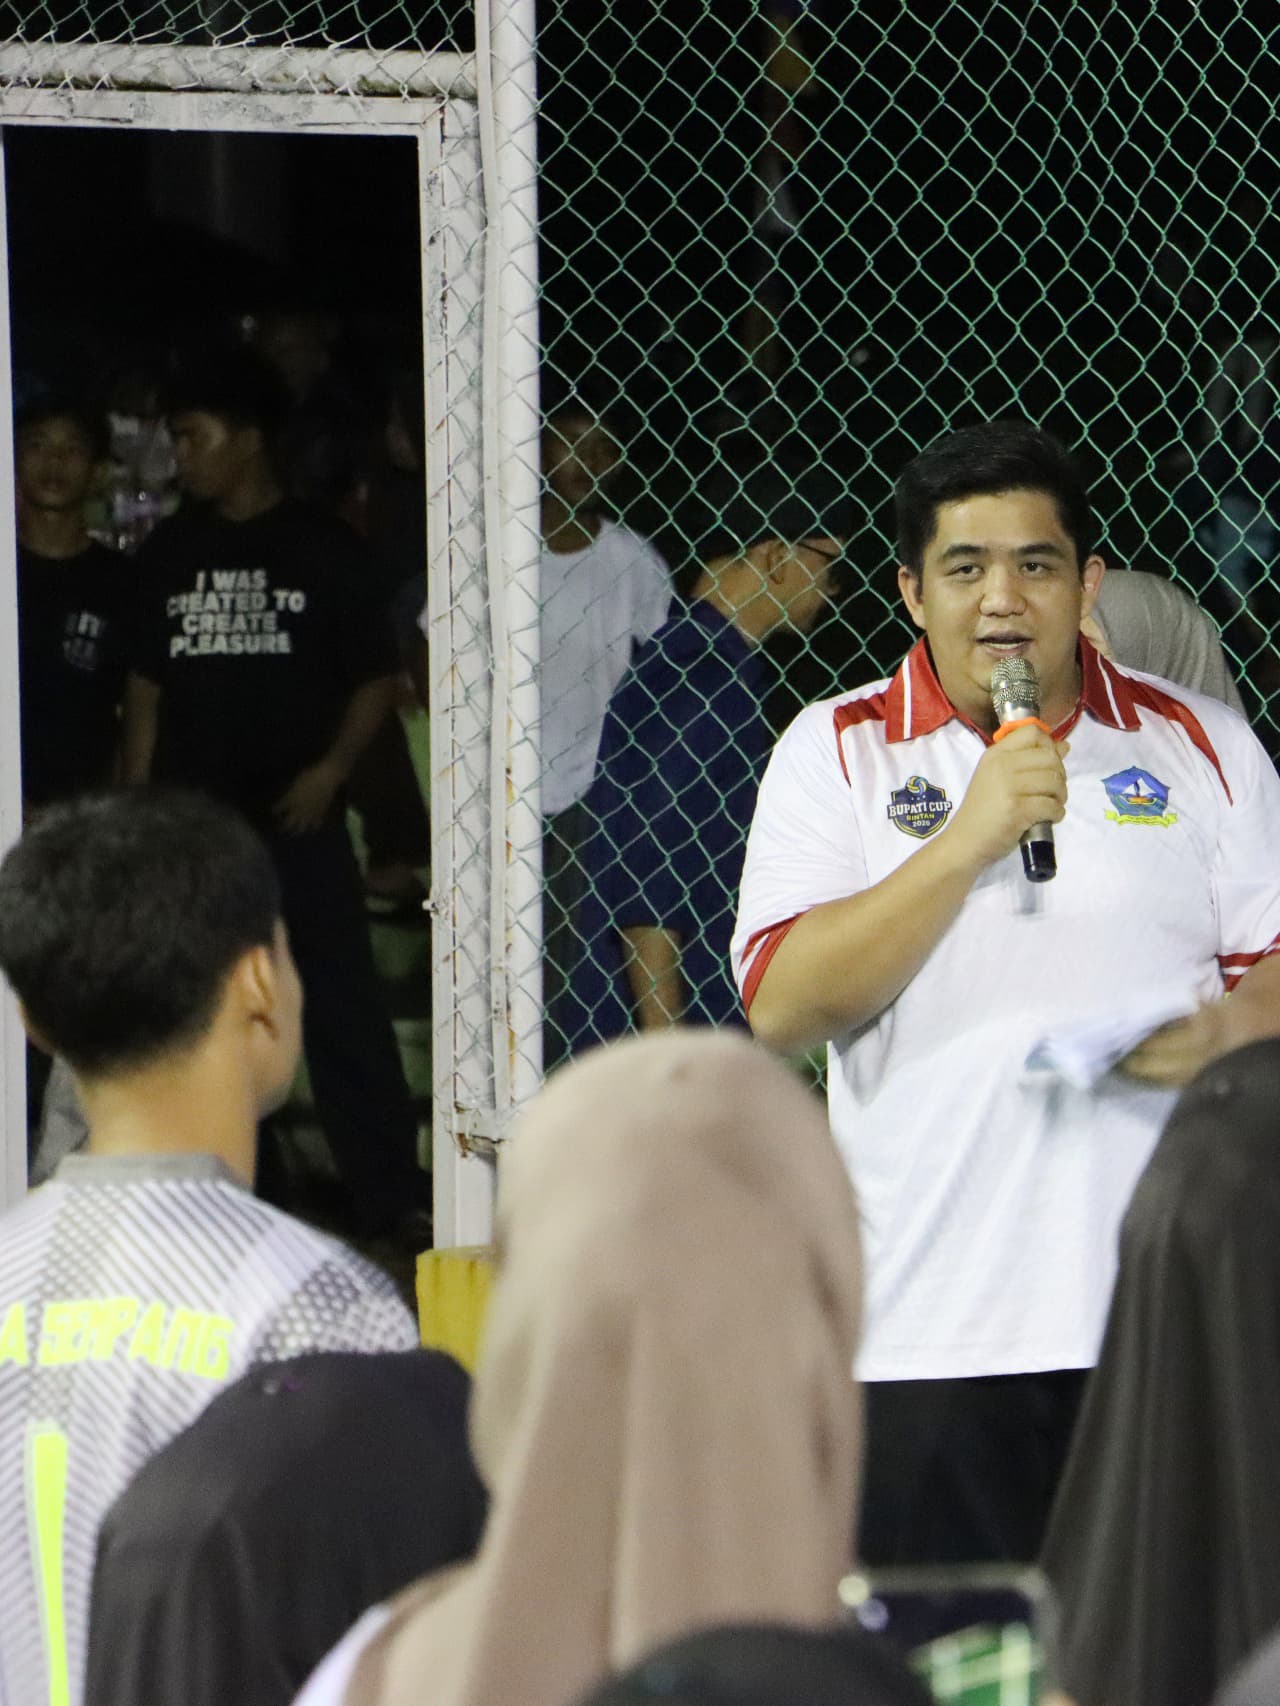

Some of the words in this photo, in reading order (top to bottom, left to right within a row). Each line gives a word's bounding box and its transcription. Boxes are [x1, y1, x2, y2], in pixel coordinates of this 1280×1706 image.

[195, 569, 207, 592] I
[211, 568, 268, 592] WAS
[272, 587, 307, 614] TO
[181, 611, 279, 636] CREATE
[169, 631, 293, 659] PLEASURE
[888, 802, 927, 817] BUPATI
[928, 801, 952, 812] CUP
